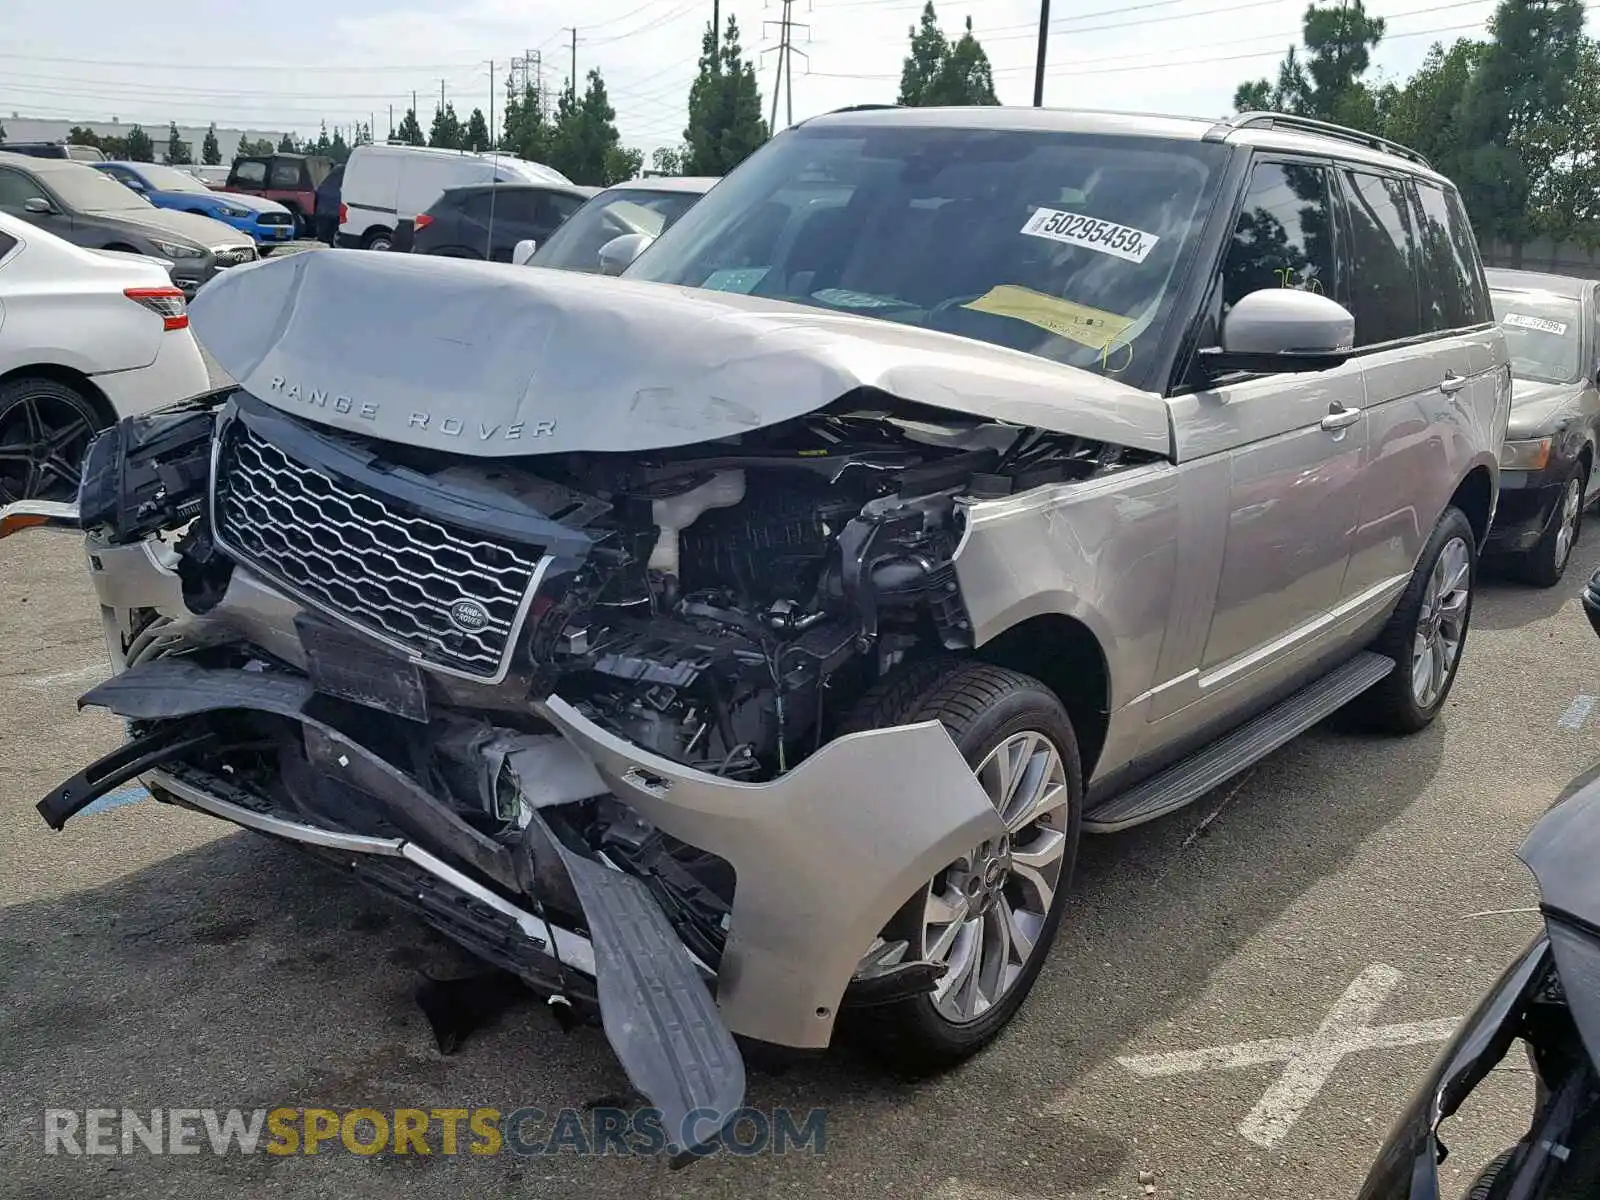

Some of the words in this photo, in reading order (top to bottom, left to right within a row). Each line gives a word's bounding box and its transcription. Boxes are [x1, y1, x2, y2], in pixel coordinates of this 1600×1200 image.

[271, 375, 380, 420] RANGE
[408, 409, 557, 440] ROVER
[458, 605, 478, 616] LAND
